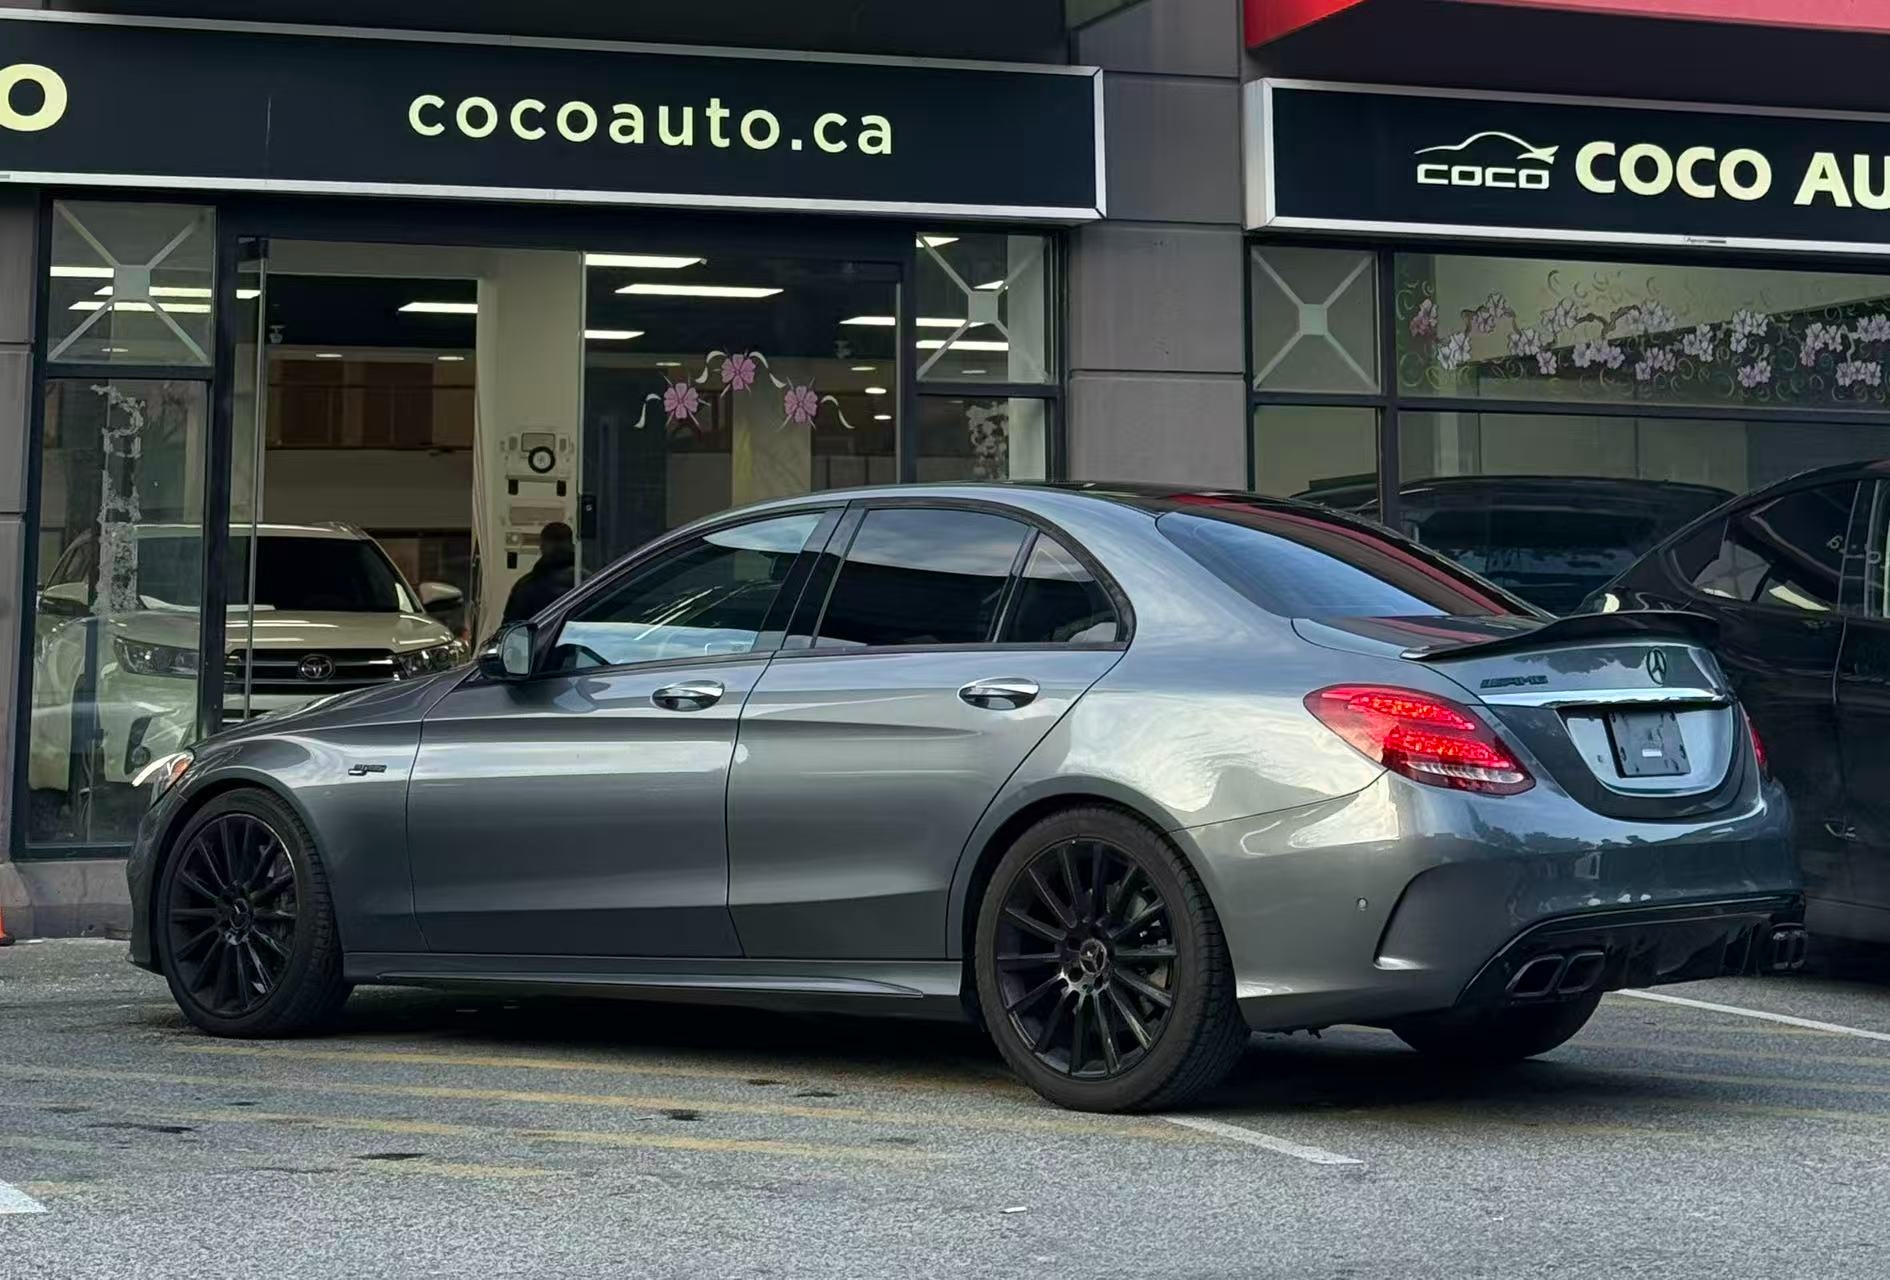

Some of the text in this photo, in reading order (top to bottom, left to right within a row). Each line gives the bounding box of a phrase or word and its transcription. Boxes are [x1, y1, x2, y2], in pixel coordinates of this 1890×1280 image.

[0, 64, 67, 131] O
[408, 94, 892, 155] cocoauto.ca
[1416, 163, 1550, 190] COCO
[1574, 140, 1890, 210] COCO AU
